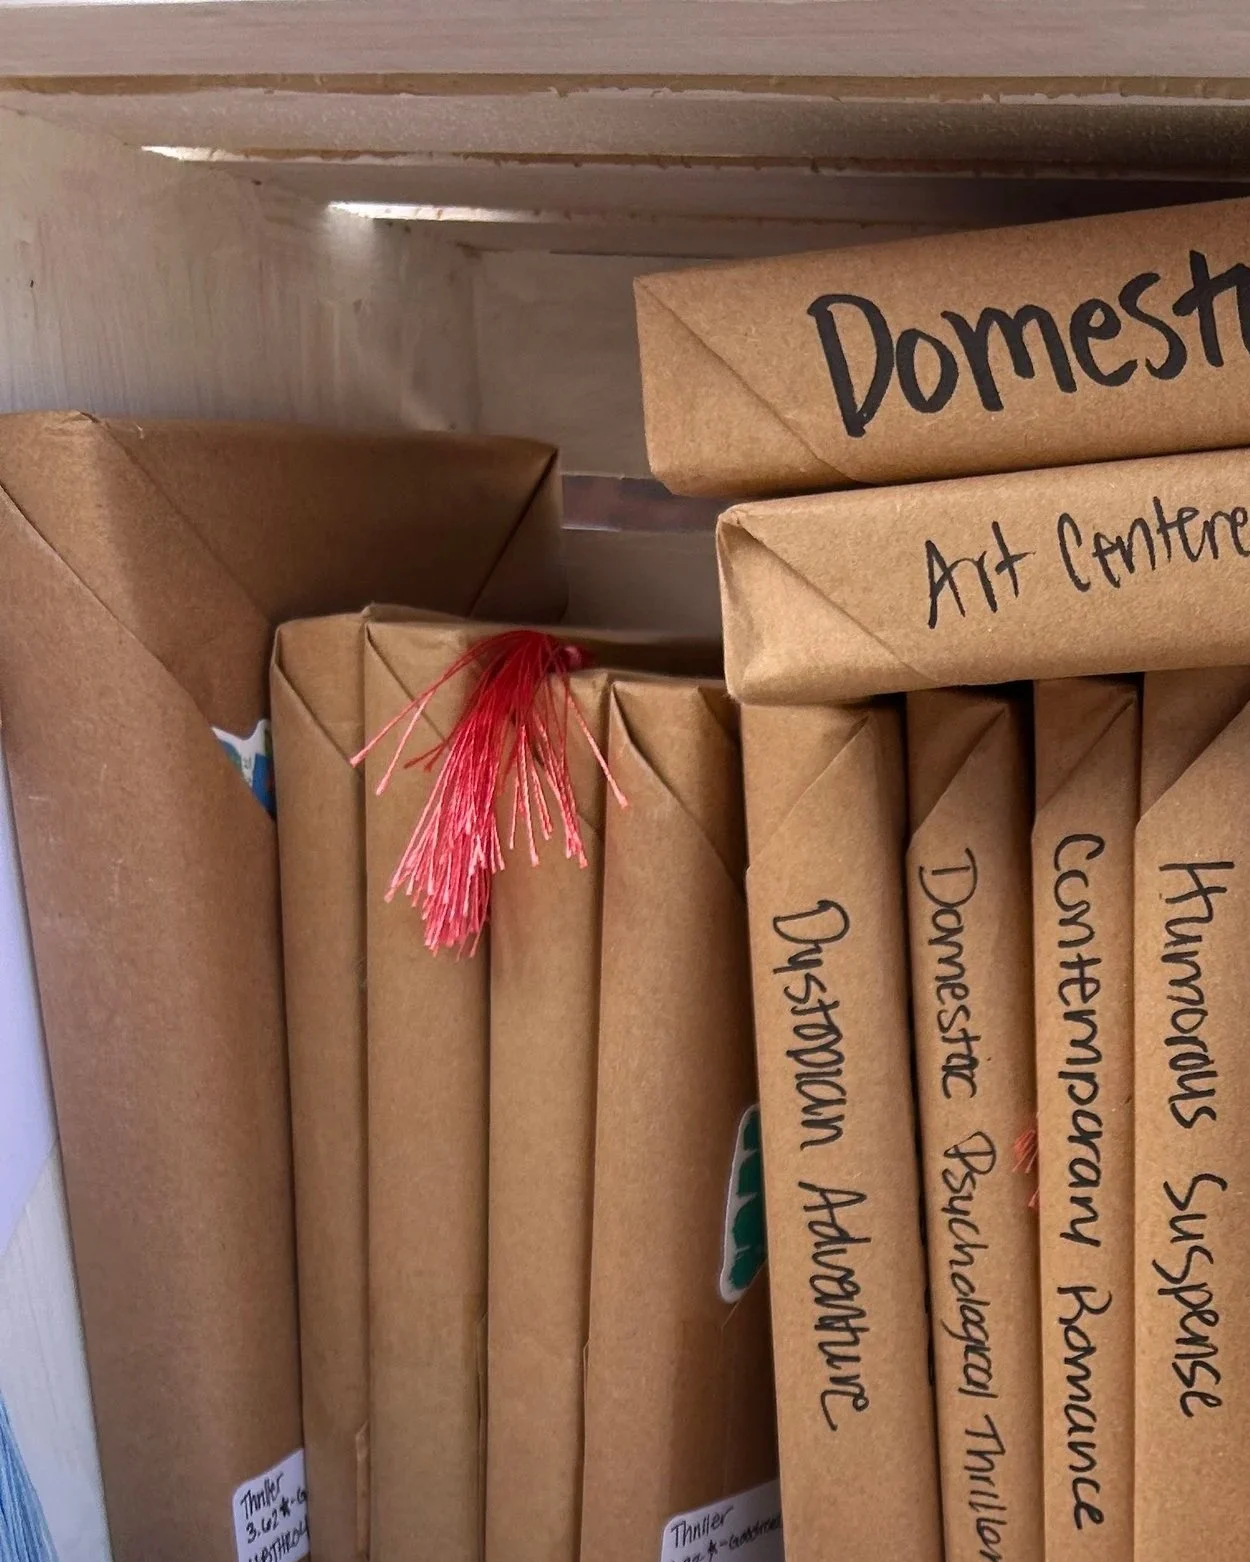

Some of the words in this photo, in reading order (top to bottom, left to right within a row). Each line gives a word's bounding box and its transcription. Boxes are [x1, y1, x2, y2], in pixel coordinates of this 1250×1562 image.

[926, 521, 1034, 628] Art
[773, 898, 850, 1150] Dystopian
[917, 848, 979, 1099] Domestic
[1053, 834, 1104, 1246] Contemporary
[1158, 860, 1234, 1130] Humorous
[799, 1180, 869, 1431] Adventure
[940, 1130, 997, 1398] Psychological
[1151, 1172, 1228, 1417] Suspense
[240, 1473, 283, 1516] Thriller
[671, 1507, 733, 1548] Thriller
[1057, 1284, 1114, 1530] Romance
